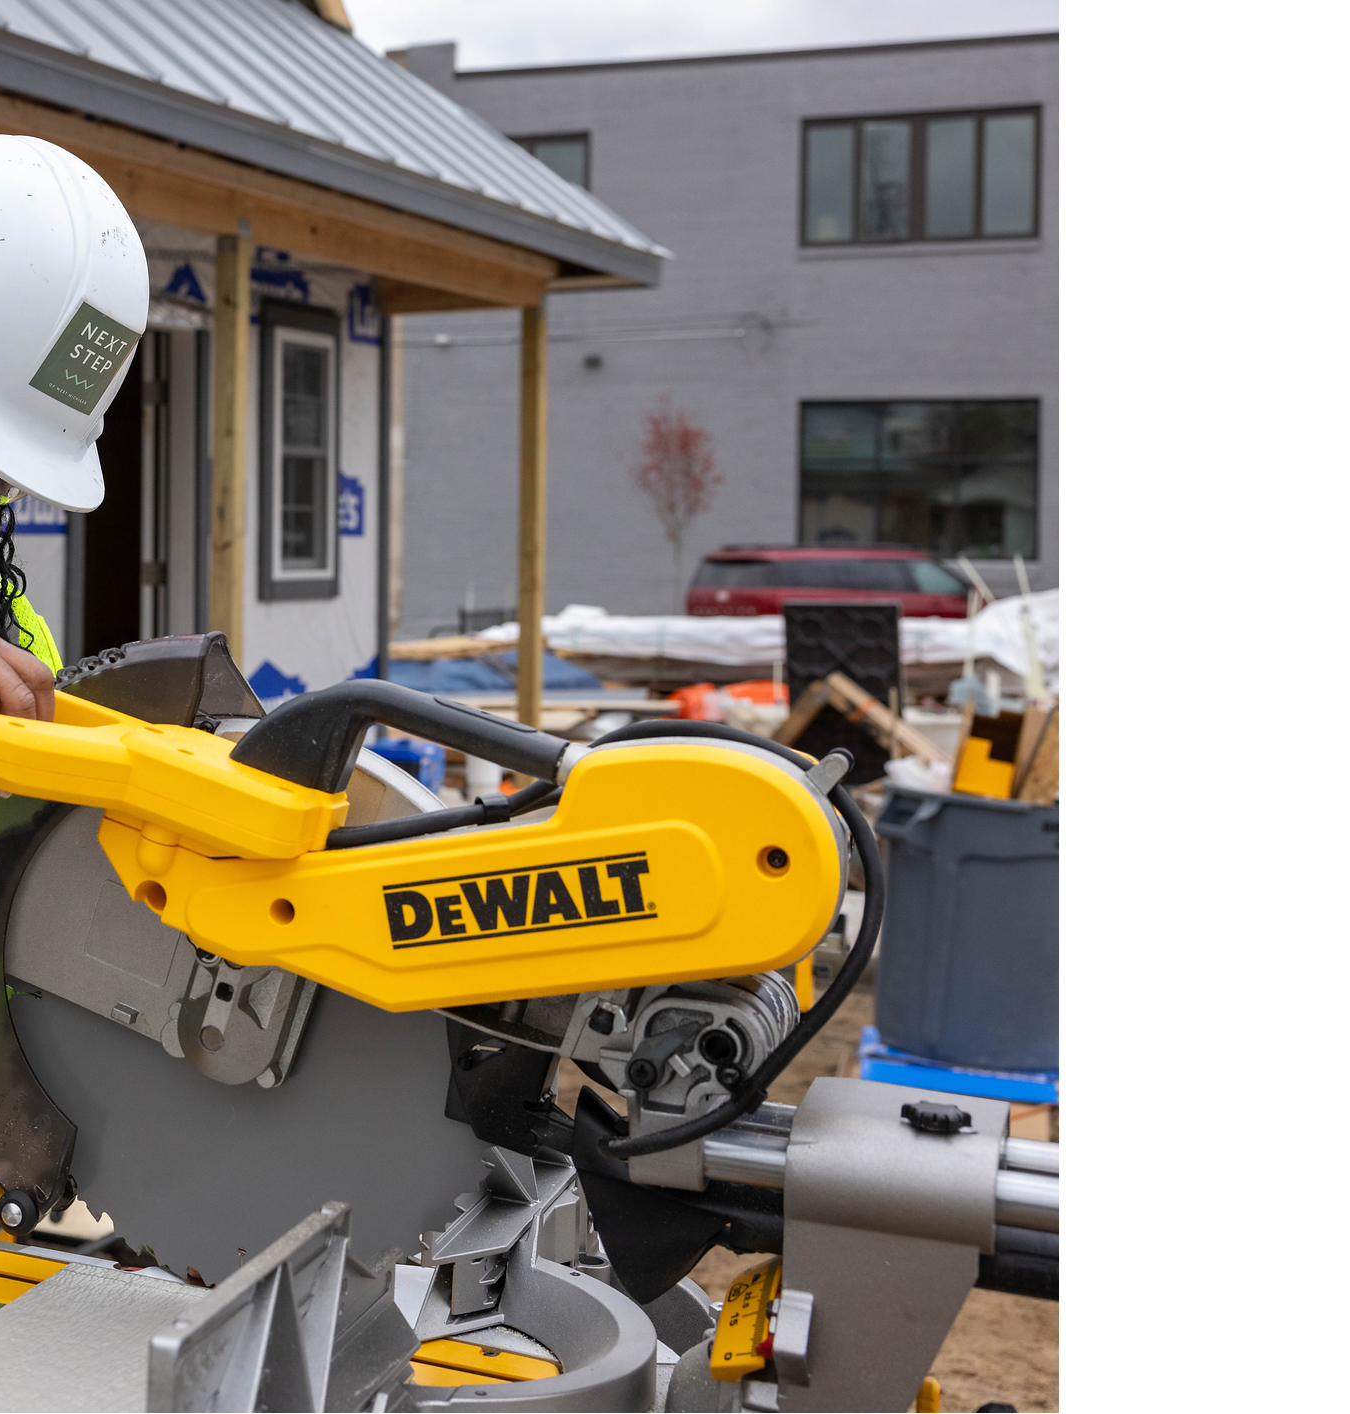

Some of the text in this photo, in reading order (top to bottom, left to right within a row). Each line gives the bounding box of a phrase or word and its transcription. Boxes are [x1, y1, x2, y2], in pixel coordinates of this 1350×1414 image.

[80, 321, 128, 356] NEXT
[69, 343, 113, 374] STEP
[383, 859, 650, 942] DEWALT
[729, 1312, 739, 1327] 15
